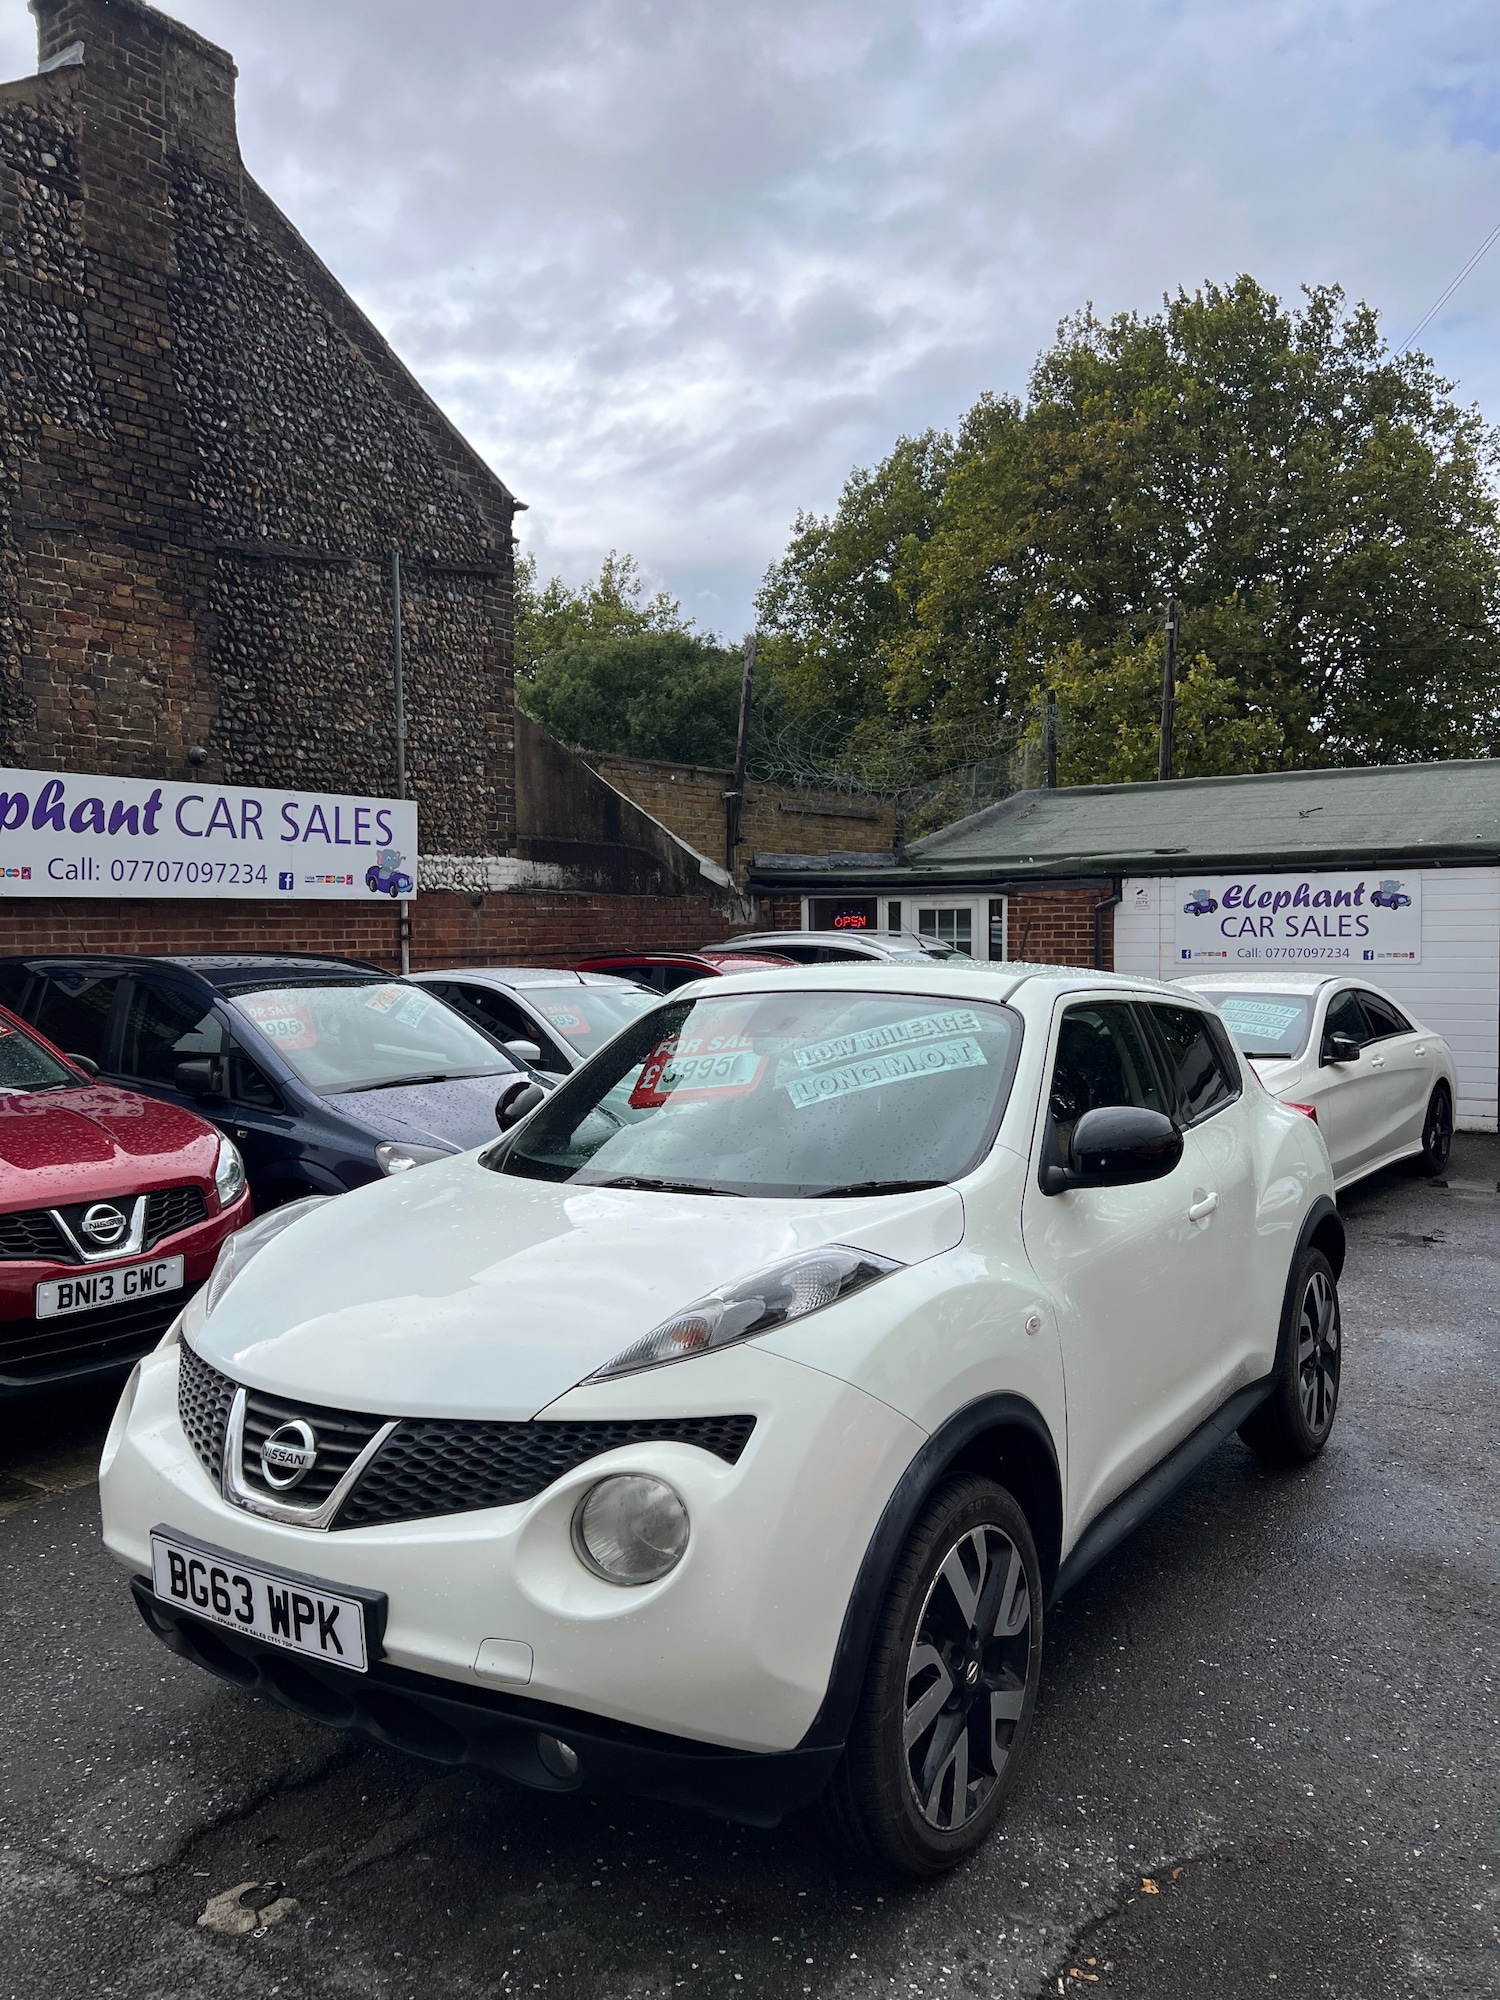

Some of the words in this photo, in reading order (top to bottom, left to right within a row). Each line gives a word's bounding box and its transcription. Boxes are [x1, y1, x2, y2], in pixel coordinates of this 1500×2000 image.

[176, 796, 263, 840] CAR
[280, 803, 393, 847] SALES
[47, 857, 100, 881] Call:
[111, 859, 268, 885] 07707097234
[1222, 882, 1365, 915] Elephant
[834, 915, 867, 928] OPEN
[1220, 916, 1275, 938] CAR
[1286, 914, 1370, 937] SALES
[1237, 948, 1261, 958] Call:
[1266, 948, 1350, 958] 07707097234
[246, 1008, 265, 1018] OR
[268, 1004, 295, 1016] SALE
[654, 1038, 702, 1058] FOR
[706, 1034, 753, 1050] SAL
[802, 1038, 857, 1066] LOW
[859, 1013, 976, 1049] MILEAGE
[795, 1064, 881, 1101] LONG
[88, 1217, 125, 1230] NISSAN
[57, 1276, 114, 1310] BN13
[123, 1264, 168, 1296] GWC
[263, 1444, 306, 1466] NISSAN
[167, 1550, 254, 1625] BG63
[267, 1585, 344, 1655] WPK
[211, 1615, 237, 1629] ELEPHANT
[238, 1625, 249, 1633] CAR
[249, 1629, 266, 1640] SALES
[267, 1636, 281, 1644] CT11
